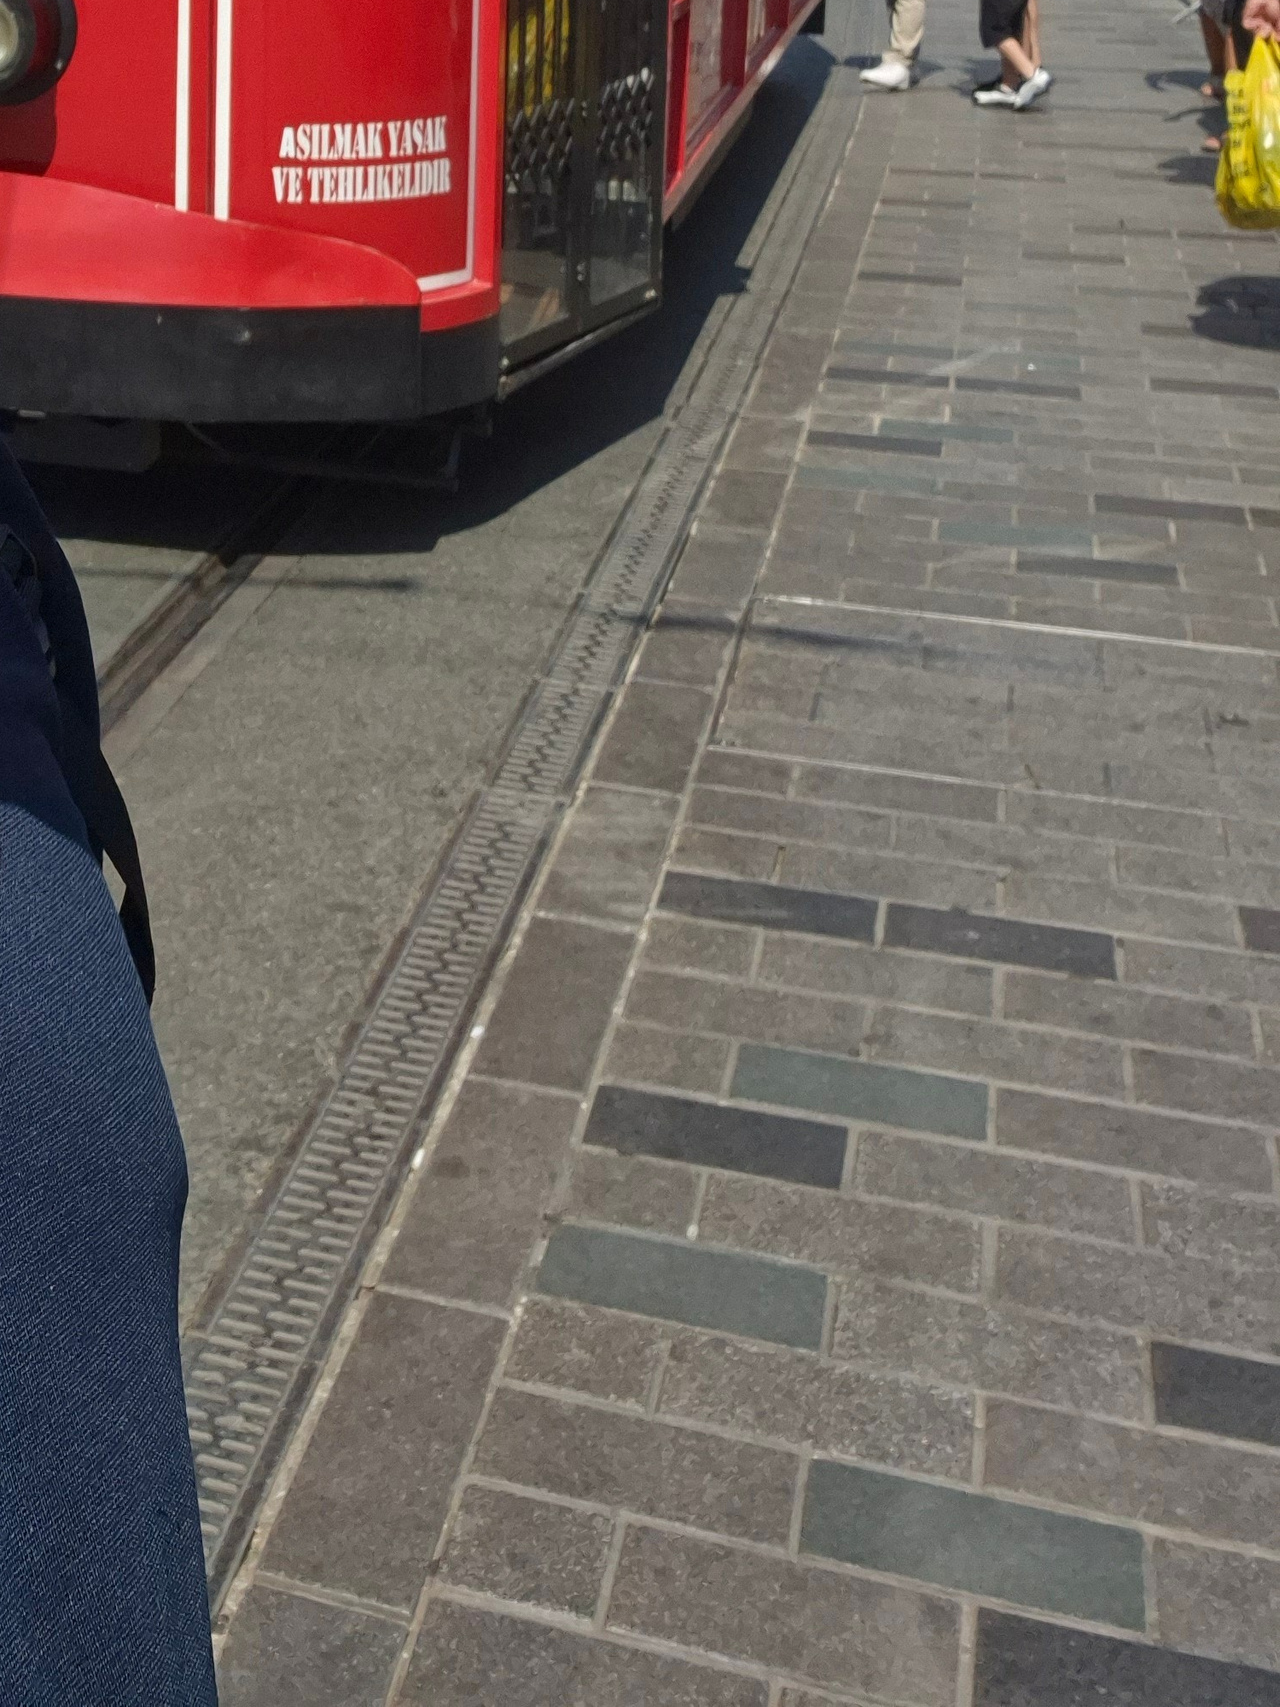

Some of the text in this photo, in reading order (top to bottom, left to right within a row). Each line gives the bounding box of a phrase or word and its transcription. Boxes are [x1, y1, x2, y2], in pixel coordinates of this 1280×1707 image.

[279, 115, 447, 161] ASILMAK YASAK
[272, 166, 303, 204] VE
